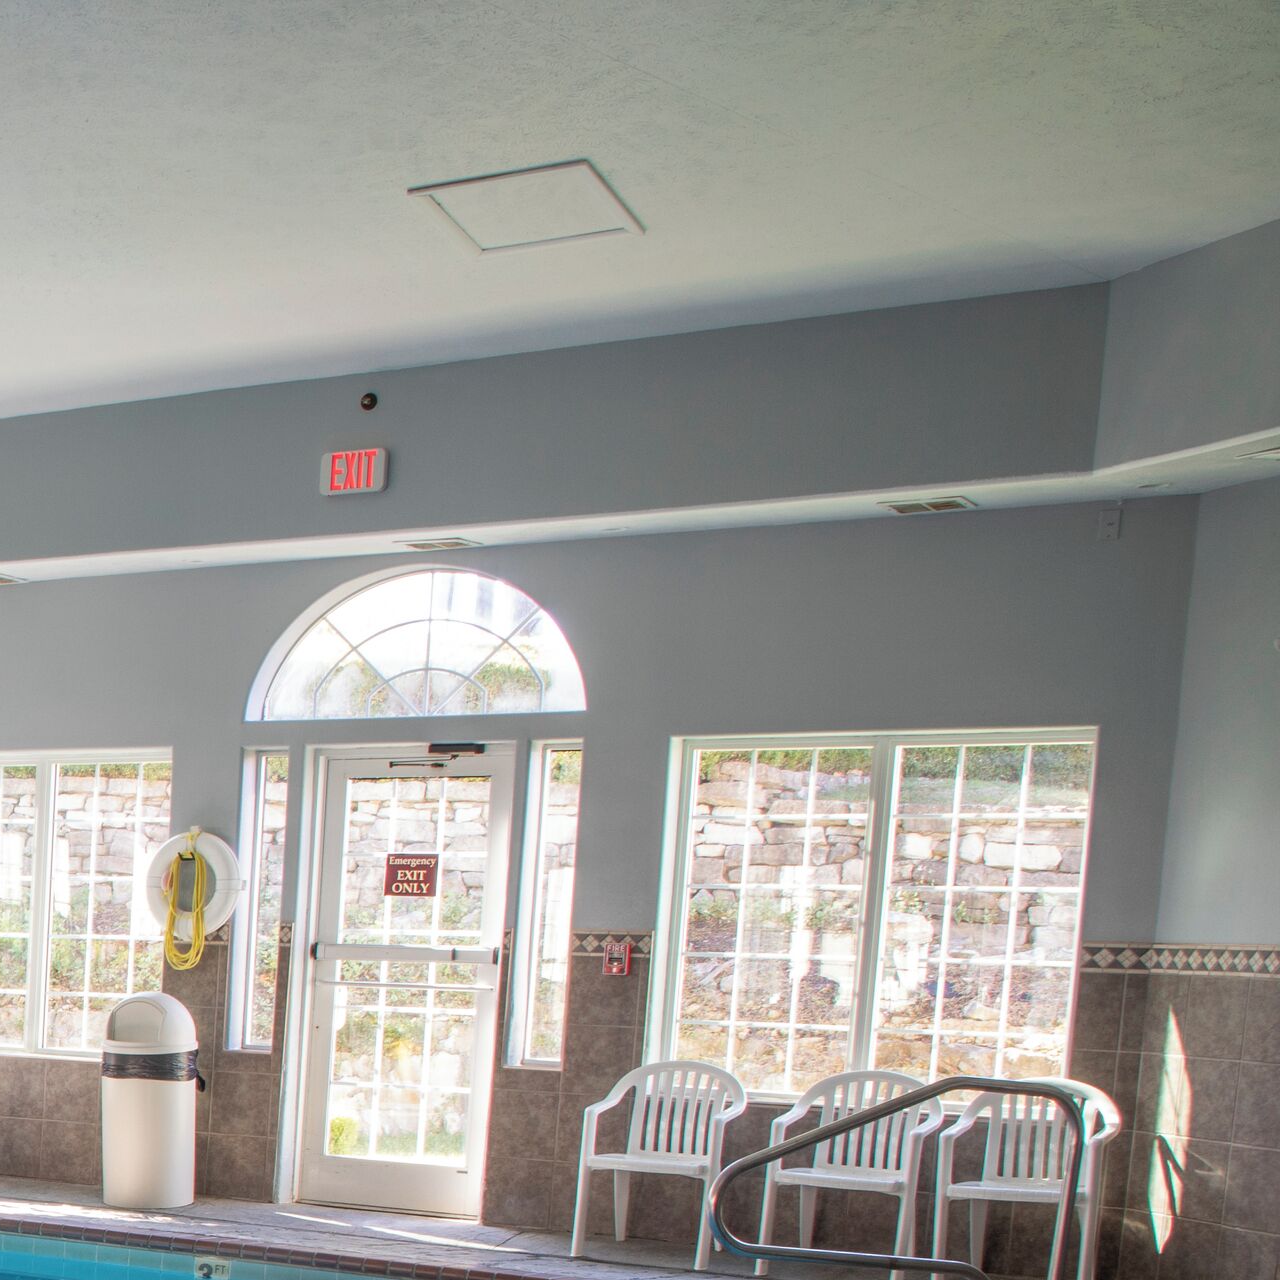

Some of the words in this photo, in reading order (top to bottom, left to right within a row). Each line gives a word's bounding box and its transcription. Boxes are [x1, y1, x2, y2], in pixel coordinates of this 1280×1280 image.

[329, 448, 378, 491] EXIT
[389, 856, 437, 868] Emergency
[397, 870, 426, 881] EXIT
[391, 882, 430, 894] ONLY
[606, 944, 625, 952] FIRE
[214, 1264, 227, 1275] FT
